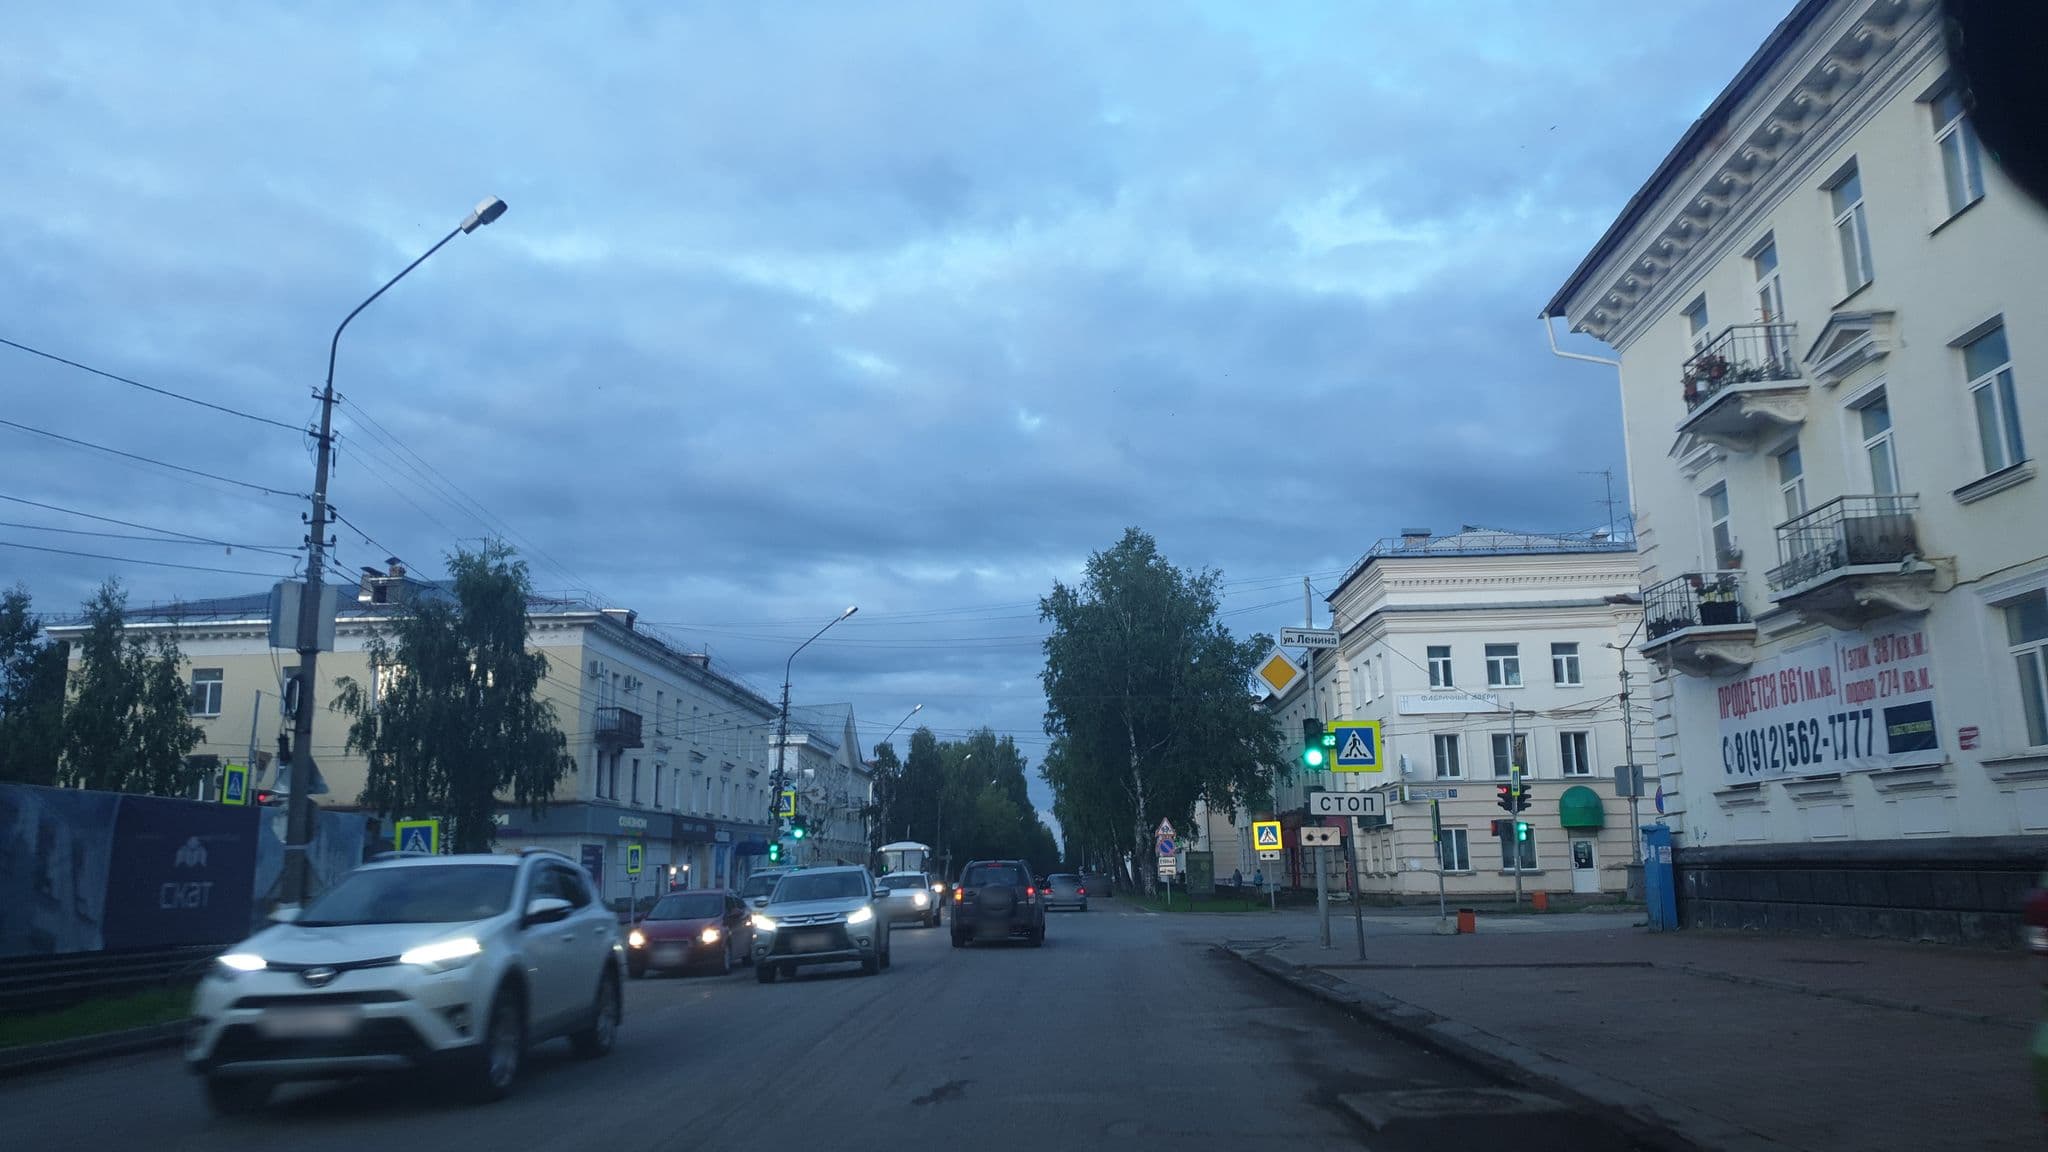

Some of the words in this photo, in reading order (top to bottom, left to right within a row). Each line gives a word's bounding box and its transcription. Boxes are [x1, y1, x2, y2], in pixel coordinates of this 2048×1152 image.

[1297, 635, 1337, 645] Ленина
[1878, 668, 1900, 698] 274
[1718, 673, 1778, 720] ПРОДАЕТСЯ
[1320, 796, 1374, 811] СТОП
